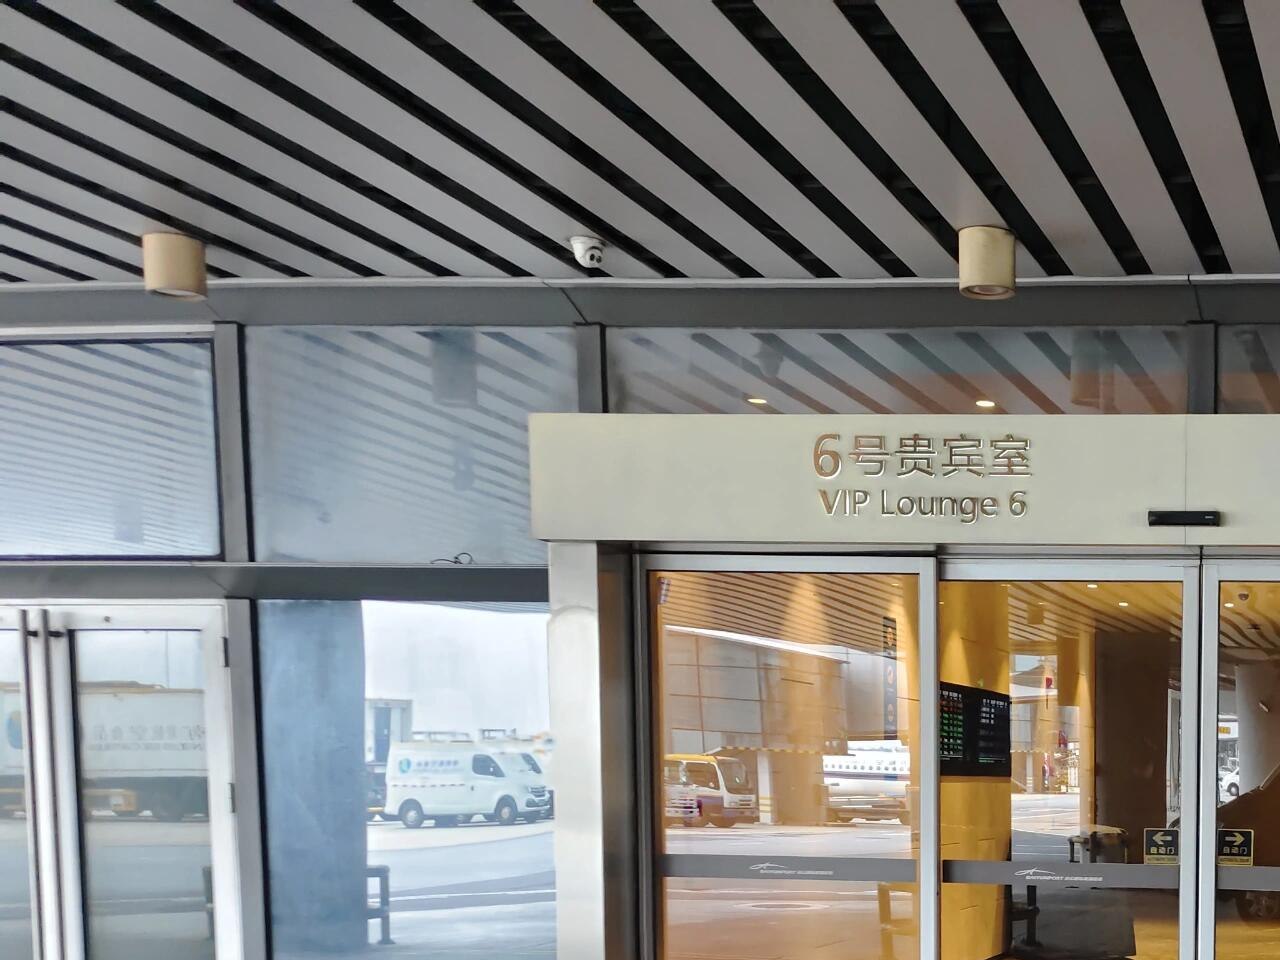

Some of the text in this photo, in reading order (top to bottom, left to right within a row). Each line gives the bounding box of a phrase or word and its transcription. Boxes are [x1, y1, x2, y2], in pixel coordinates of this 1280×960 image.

[813, 433, 1033, 479] 6号贵宾室
[817, 489, 1028, 524] VIP Lounge 6
